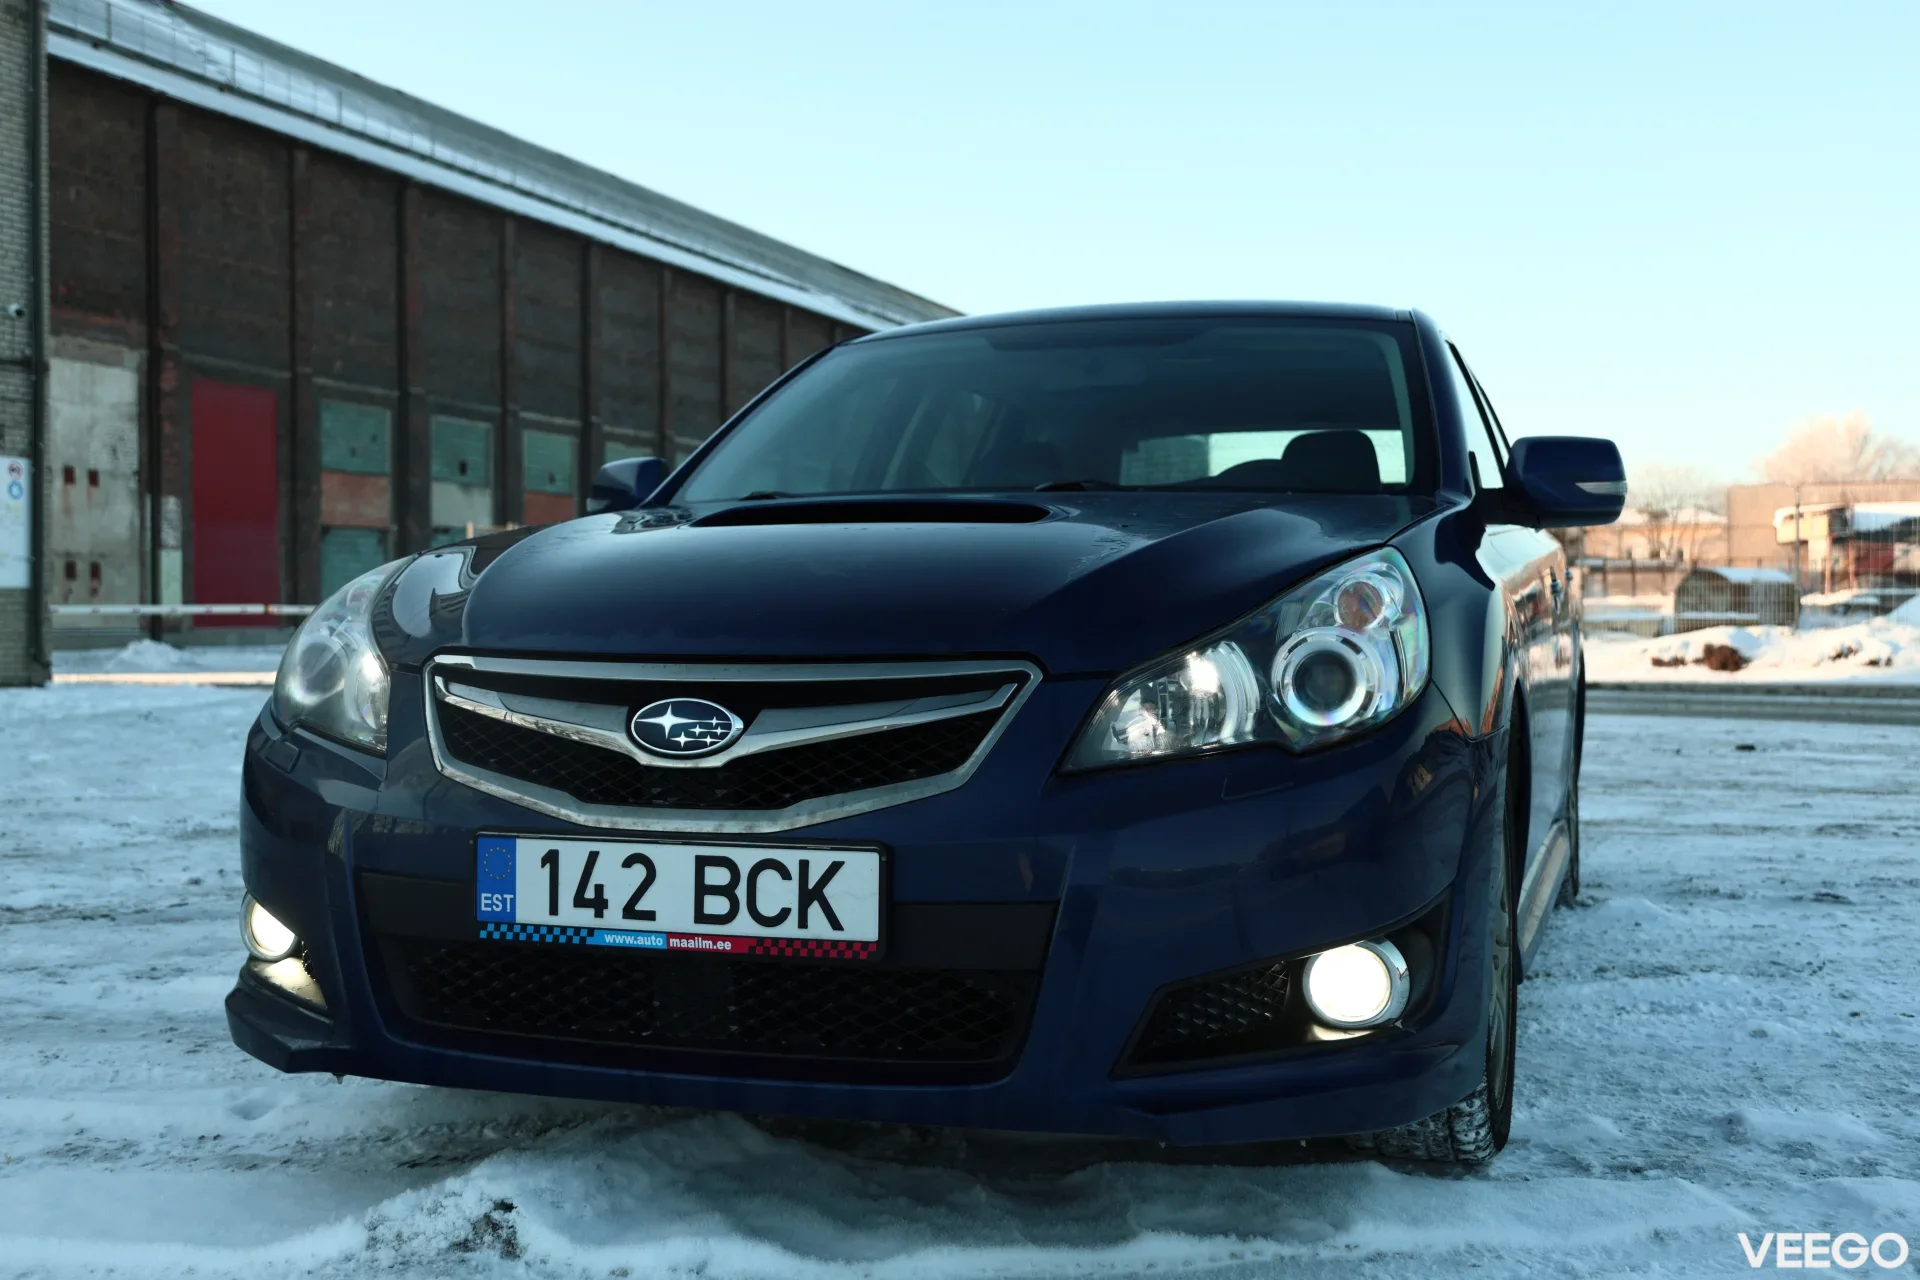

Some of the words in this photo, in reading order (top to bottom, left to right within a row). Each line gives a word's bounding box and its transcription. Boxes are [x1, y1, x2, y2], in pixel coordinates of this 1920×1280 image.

[540, 848, 657, 921] 142
[694, 854, 845, 931] BCK
[481, 892, 514, 912] EST
[604, 933, 663, 947] www.auto
[669, 937, 732, 951] maailm.ee
